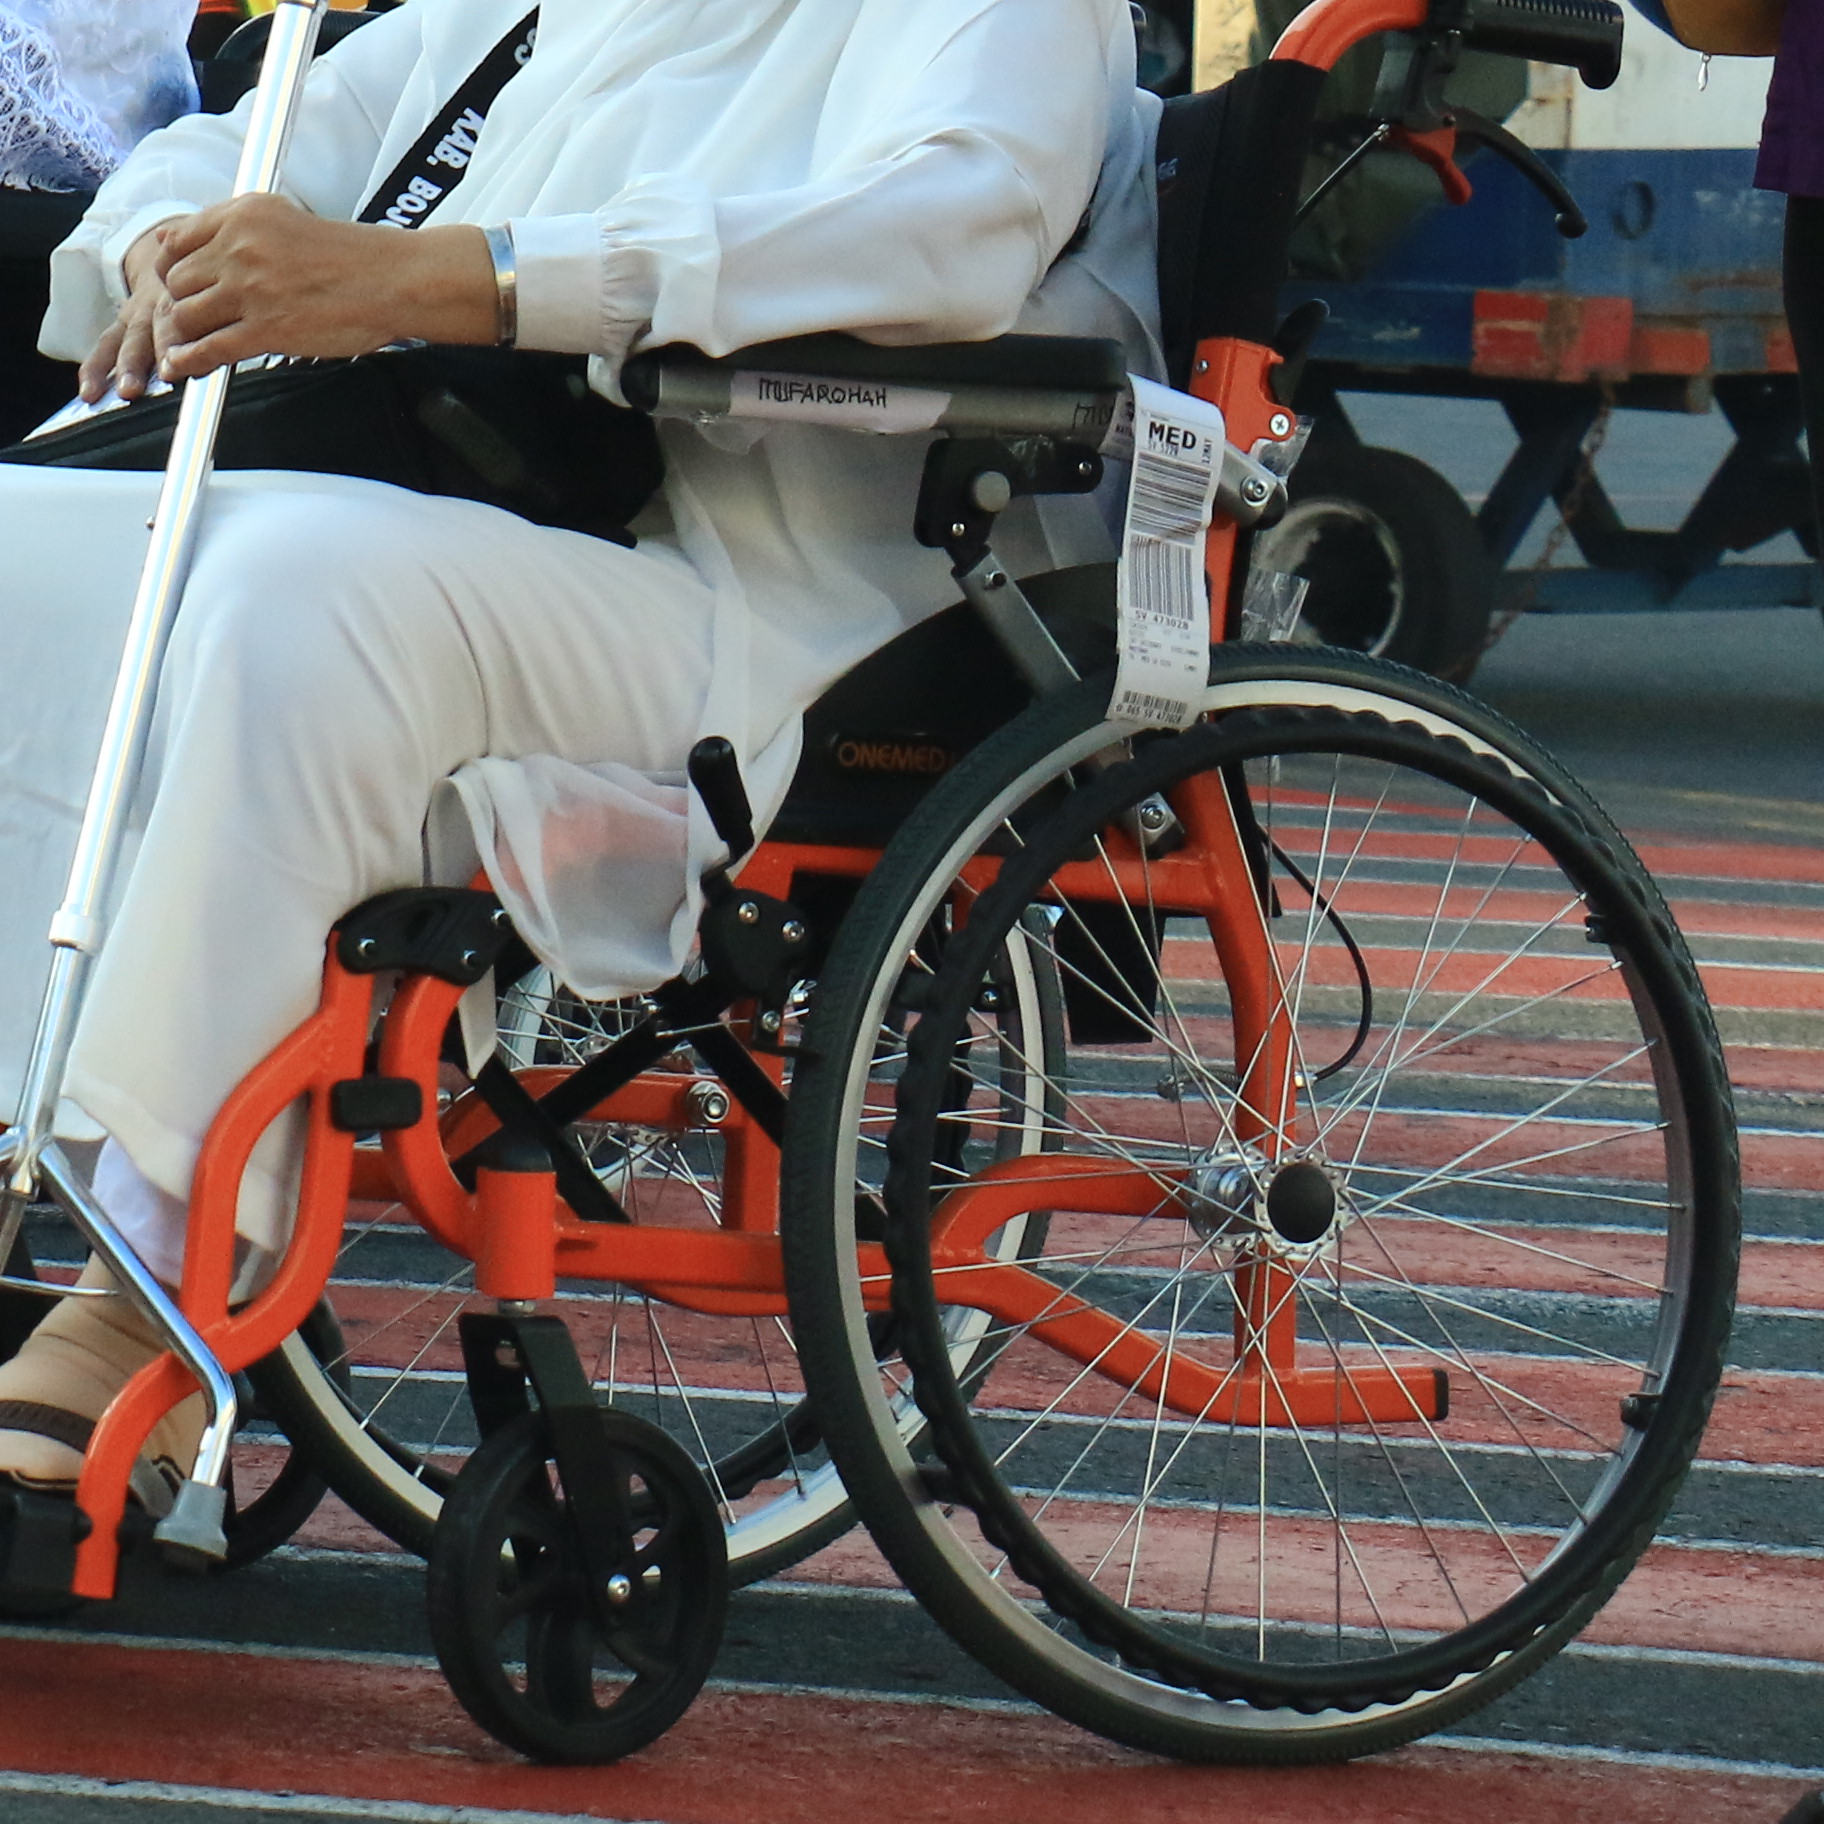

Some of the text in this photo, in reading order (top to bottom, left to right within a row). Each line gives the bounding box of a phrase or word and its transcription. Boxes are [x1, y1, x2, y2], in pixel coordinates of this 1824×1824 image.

[425, 107, 486, 170] KAB.
[1149, 421, 1197, 450] MED
[838, 741, 947, 772] ONEMED
